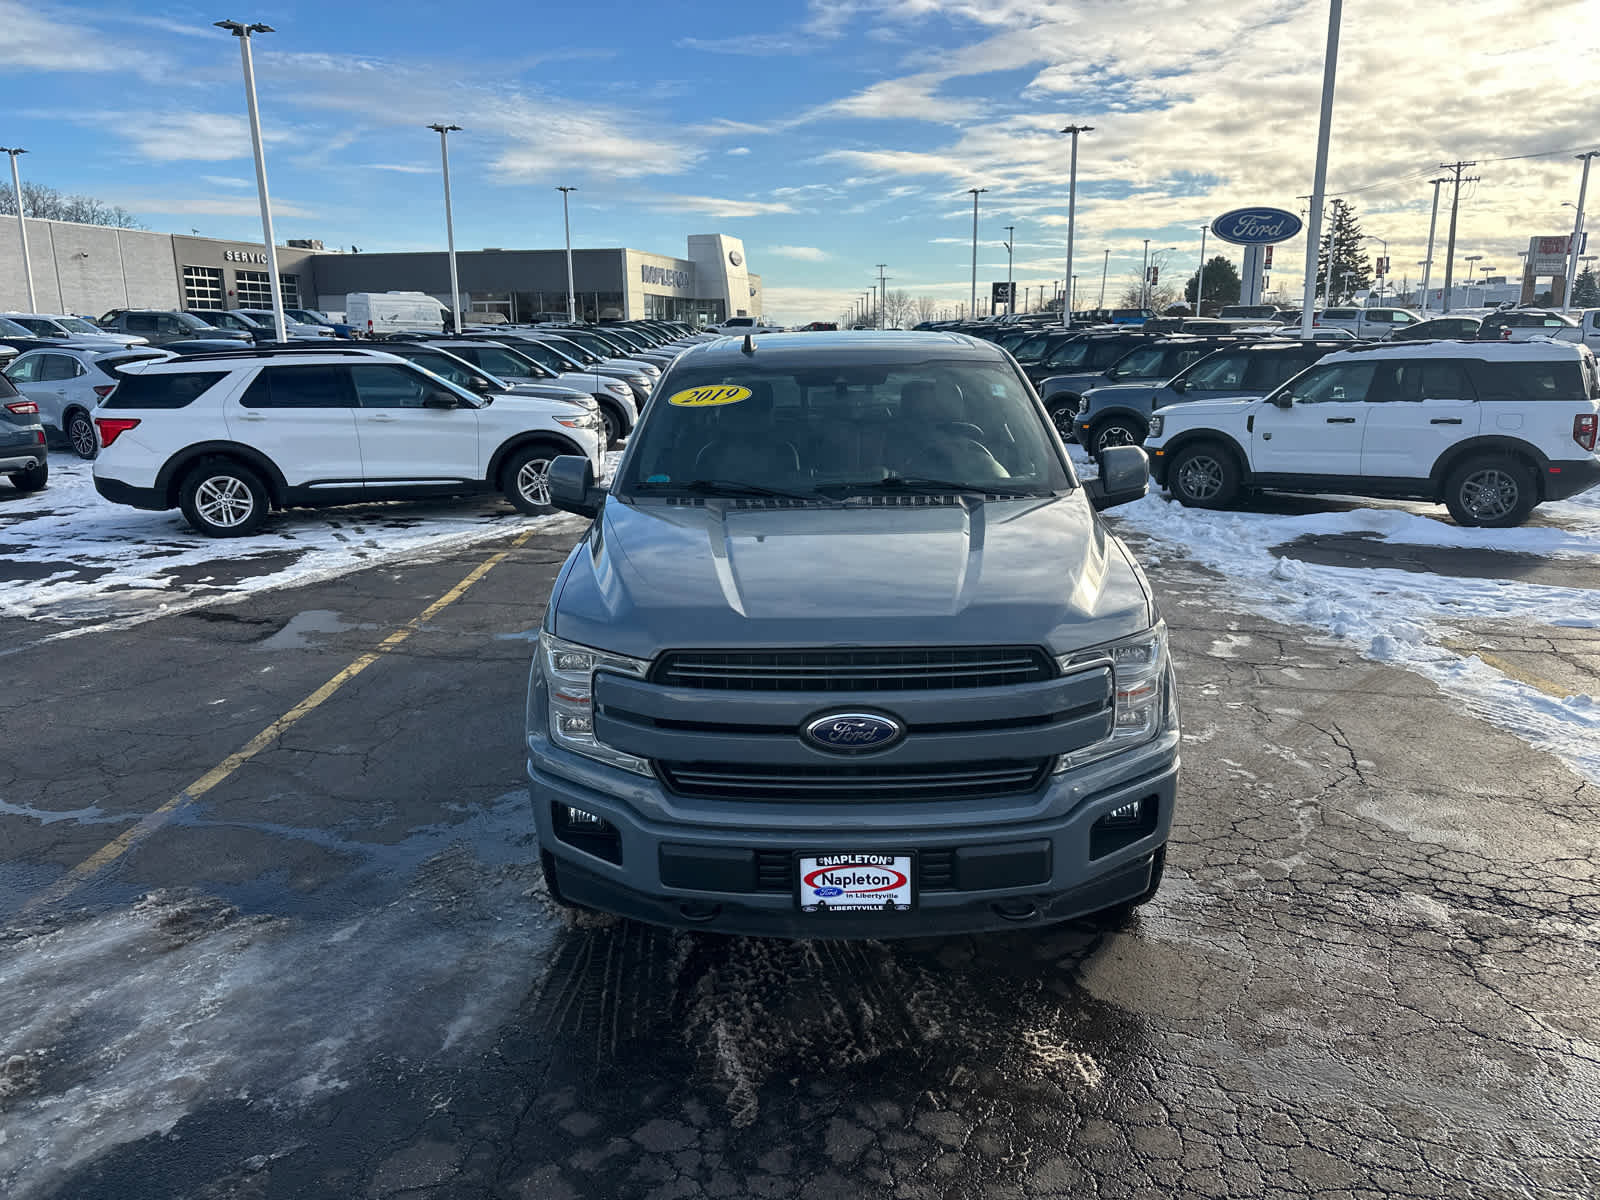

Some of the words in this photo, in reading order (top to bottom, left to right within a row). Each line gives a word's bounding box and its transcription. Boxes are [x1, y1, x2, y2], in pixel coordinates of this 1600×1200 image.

[1232, 214, 1285, 237] Ford
[225, 250, 269, 264] SERVIC
[680, 387, 740, 404] 2019
[828, 721, 878, 741] Ford
[823, 855, 888, 865] NAPLETON
[821, 872, 891, 889] Napleton
